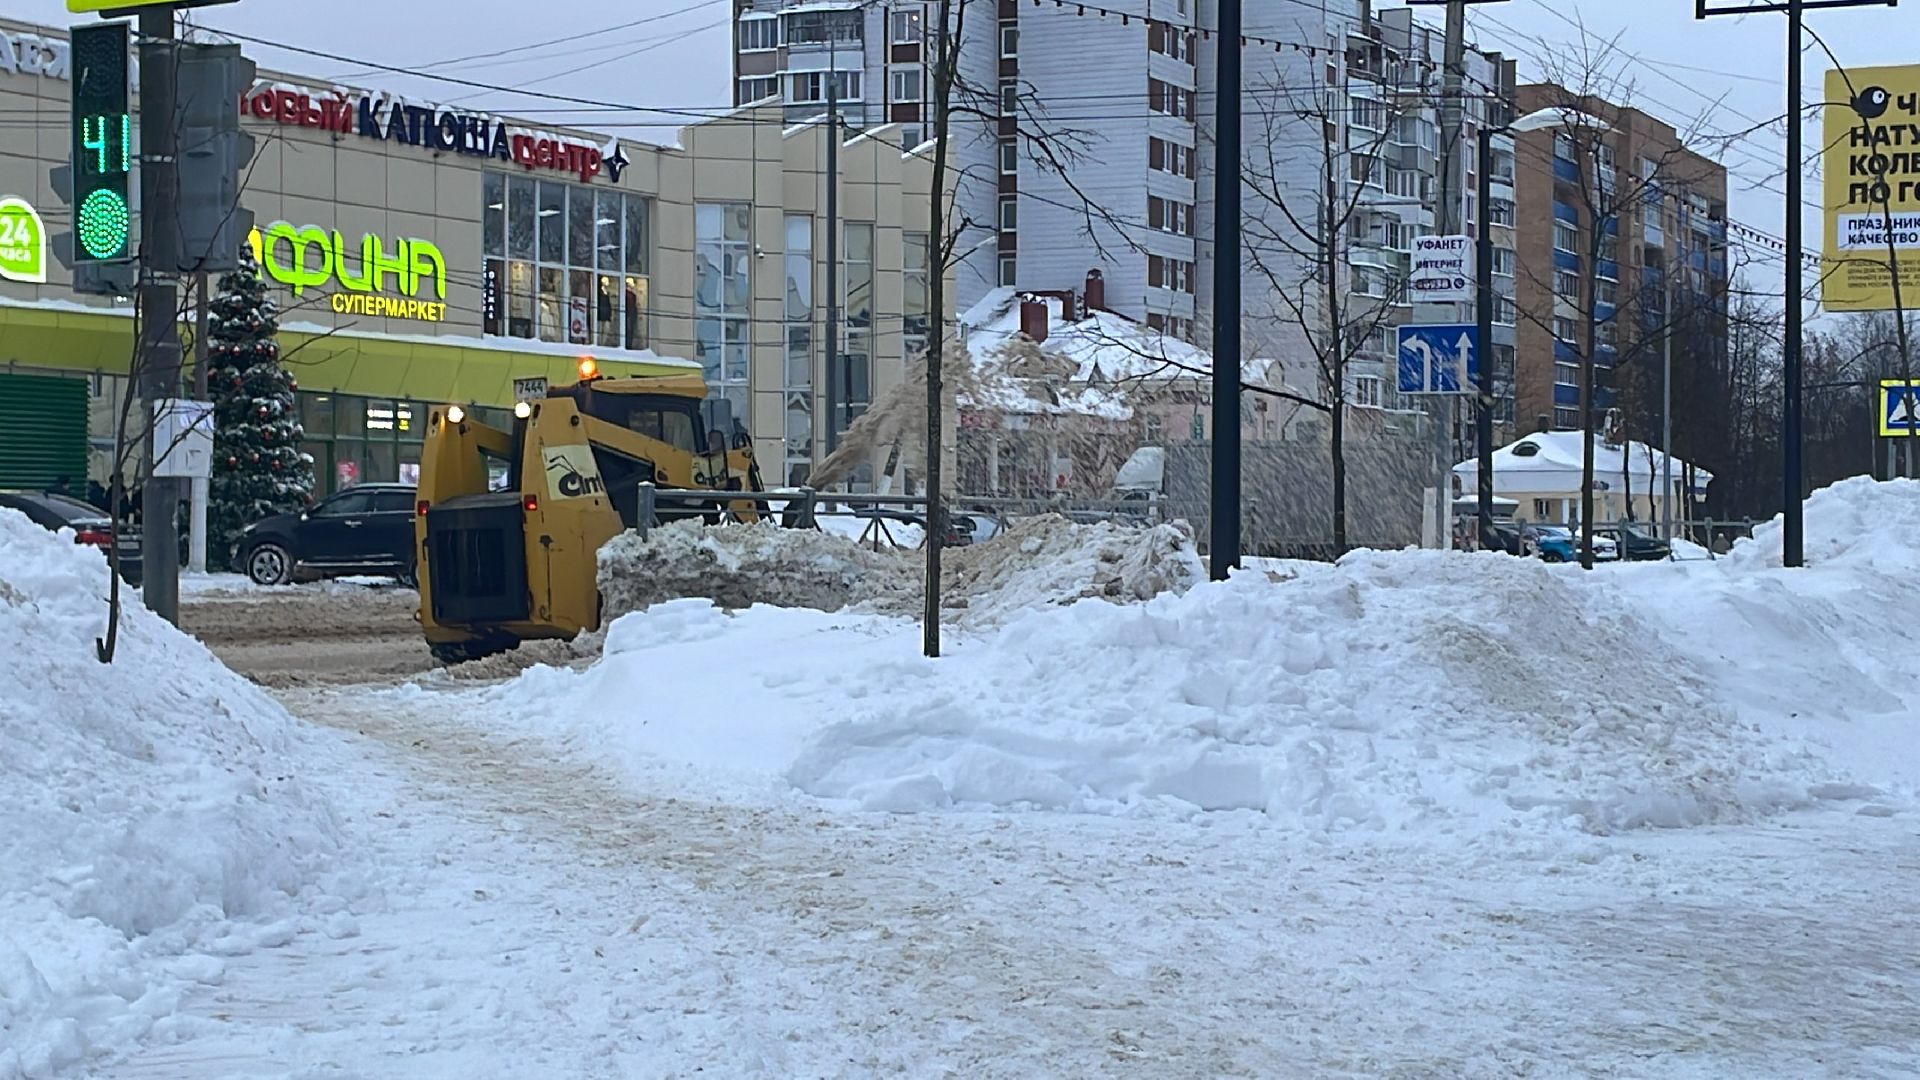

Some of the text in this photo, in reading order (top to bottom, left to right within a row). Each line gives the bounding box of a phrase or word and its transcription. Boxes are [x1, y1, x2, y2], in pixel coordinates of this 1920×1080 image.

[1897, 92, 1920, 115] Ч
[83, 114, 129, 173] 41
[359, 96, 513, 162] КАТЮША
[513, 132, 601, 184] центр
[1849, 181, 1891, 204] ПО
[0, 215, 31, 248] 24
[1848, 232, 1918, 244] КАЧЕСТВО
[1416, 239, 1465, 251] УФАНЕТ
[1415, 259, 1464, 269] ИНТЕРНЕТ
[332, 293, 447, 321] СУПЕРМАРКЕТ
[517, 380, 544, 394] 7444
